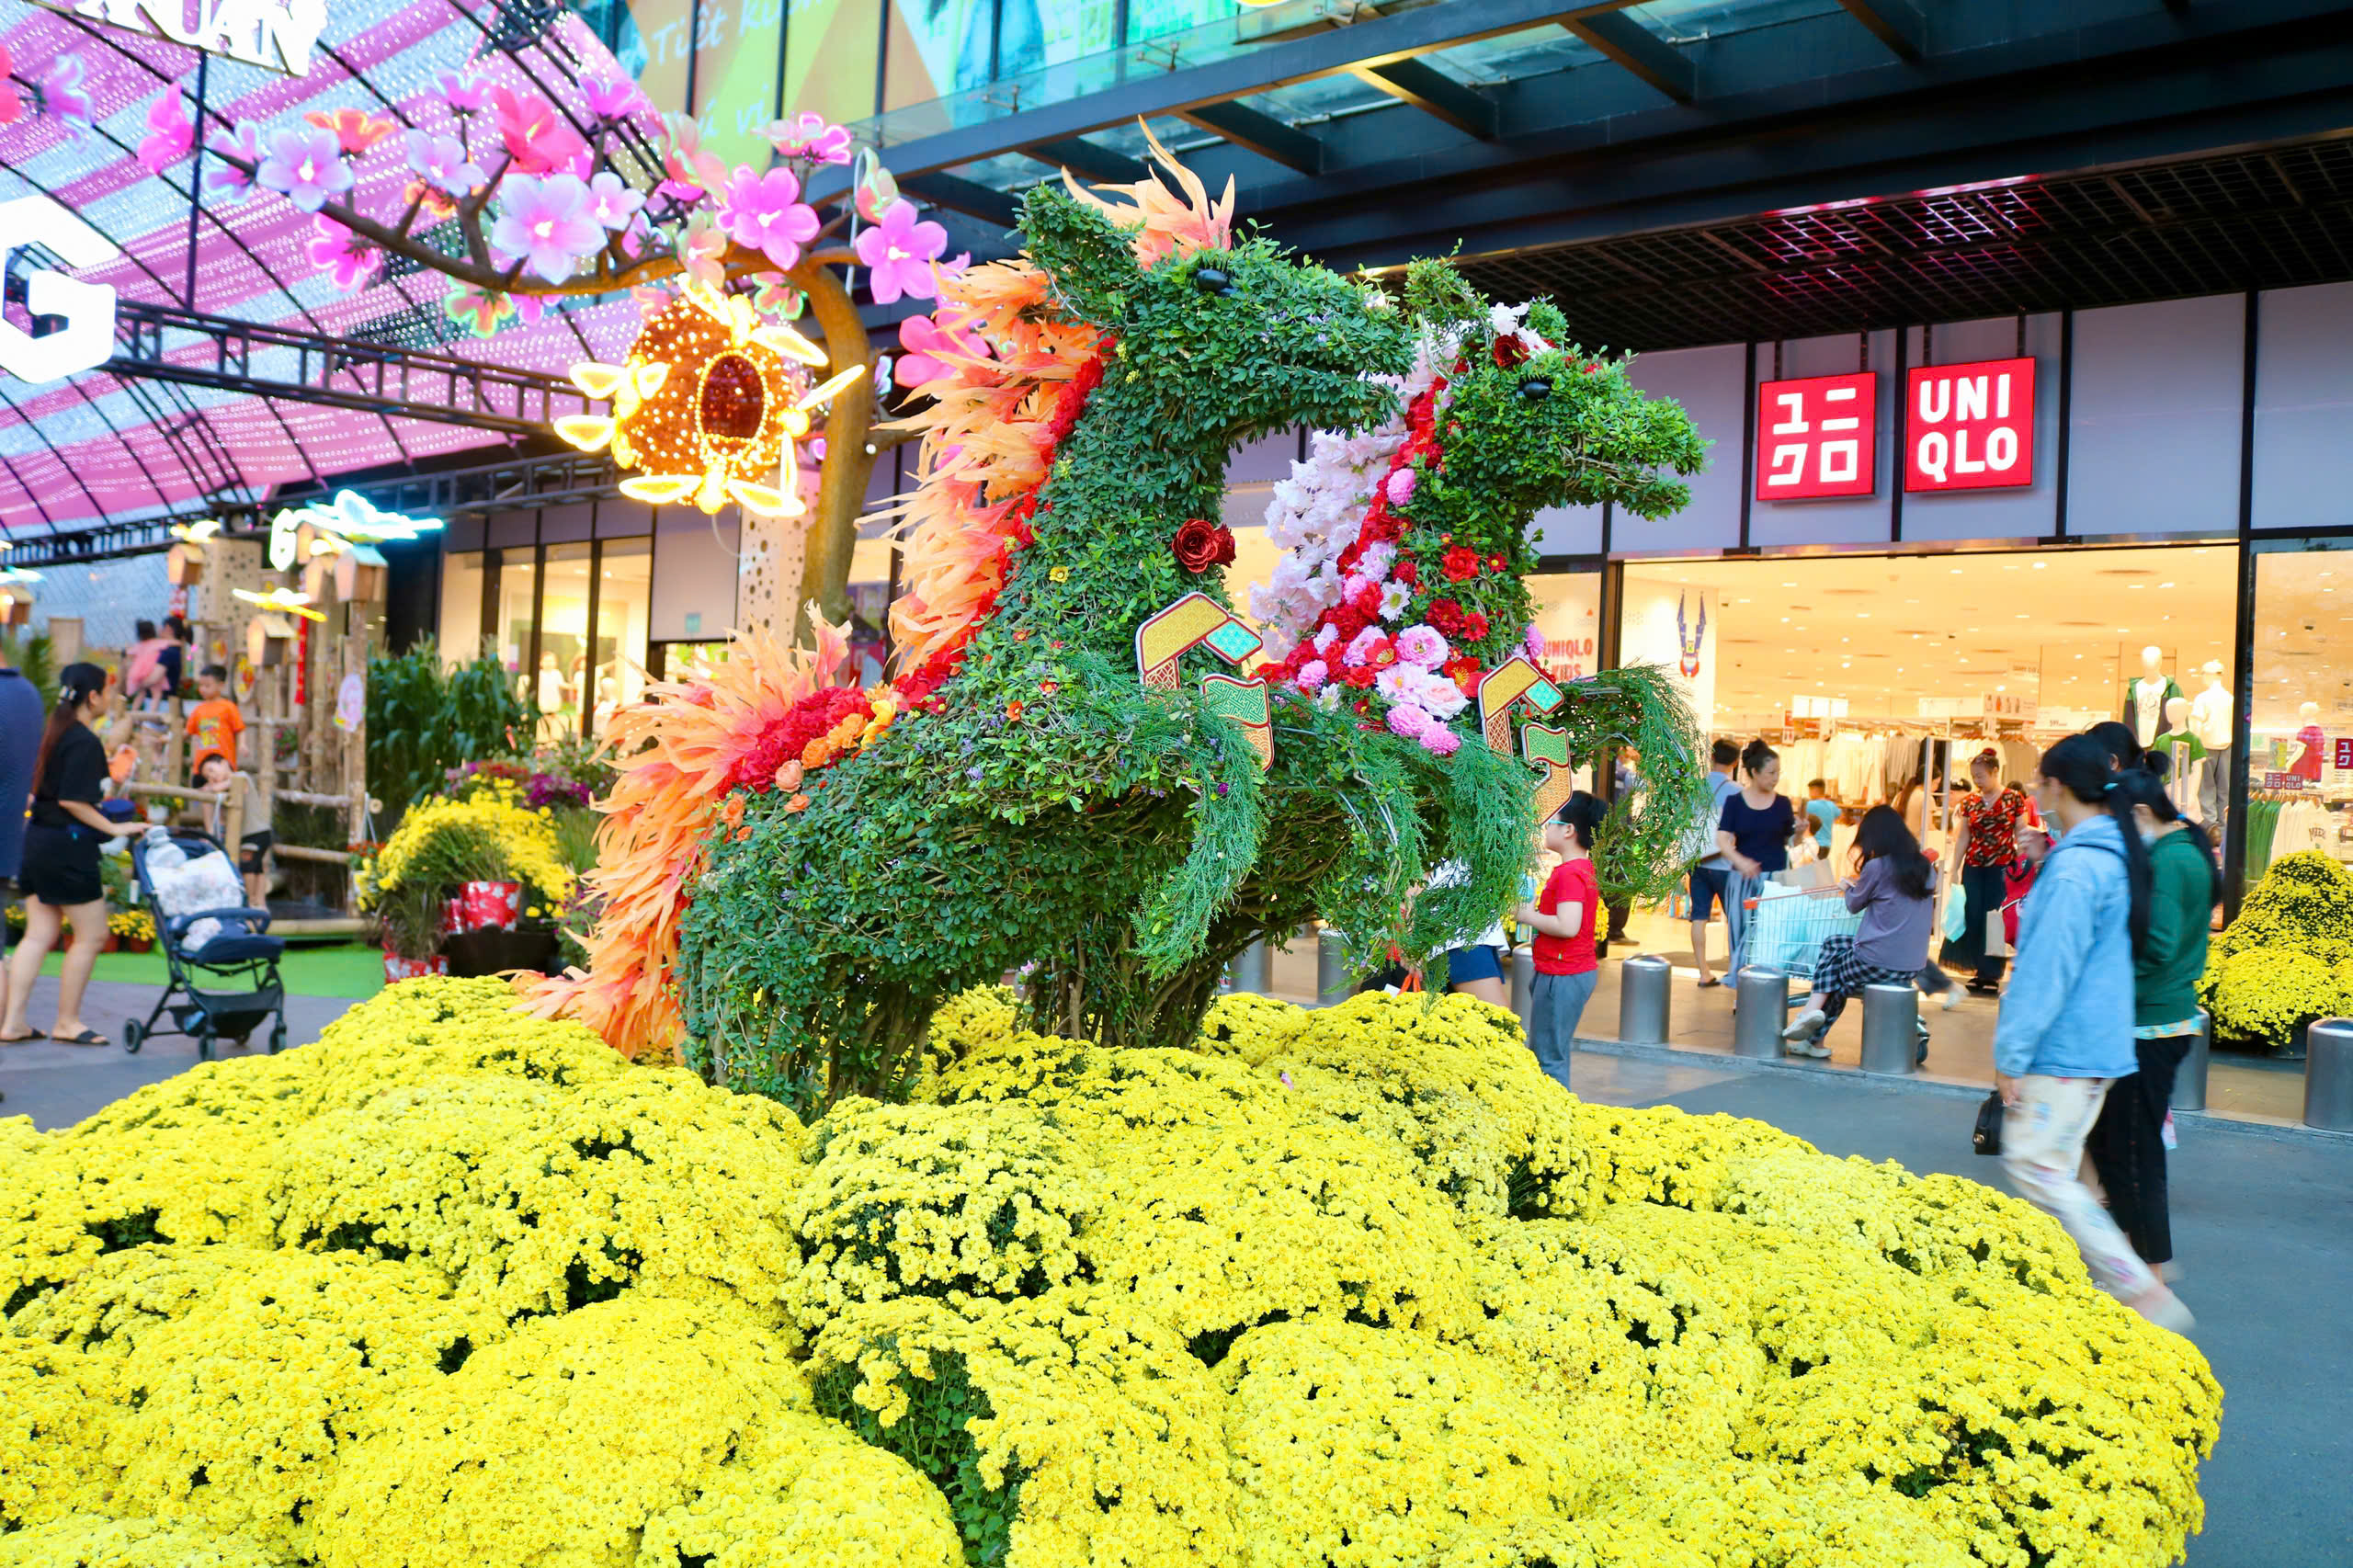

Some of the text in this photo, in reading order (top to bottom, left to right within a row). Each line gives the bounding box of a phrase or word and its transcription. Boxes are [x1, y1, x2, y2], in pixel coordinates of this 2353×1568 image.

[1772, 387, 1859, 435] ユニ
[1918, 373, 2011, 424] UNI
[1768, 439, 1859, 486] クロ
[1917, 426, 2018, 483] QLO
[1543, 637, 1593, 659] UNIQLO
[1552, 663, 1582, 682] KIDS
